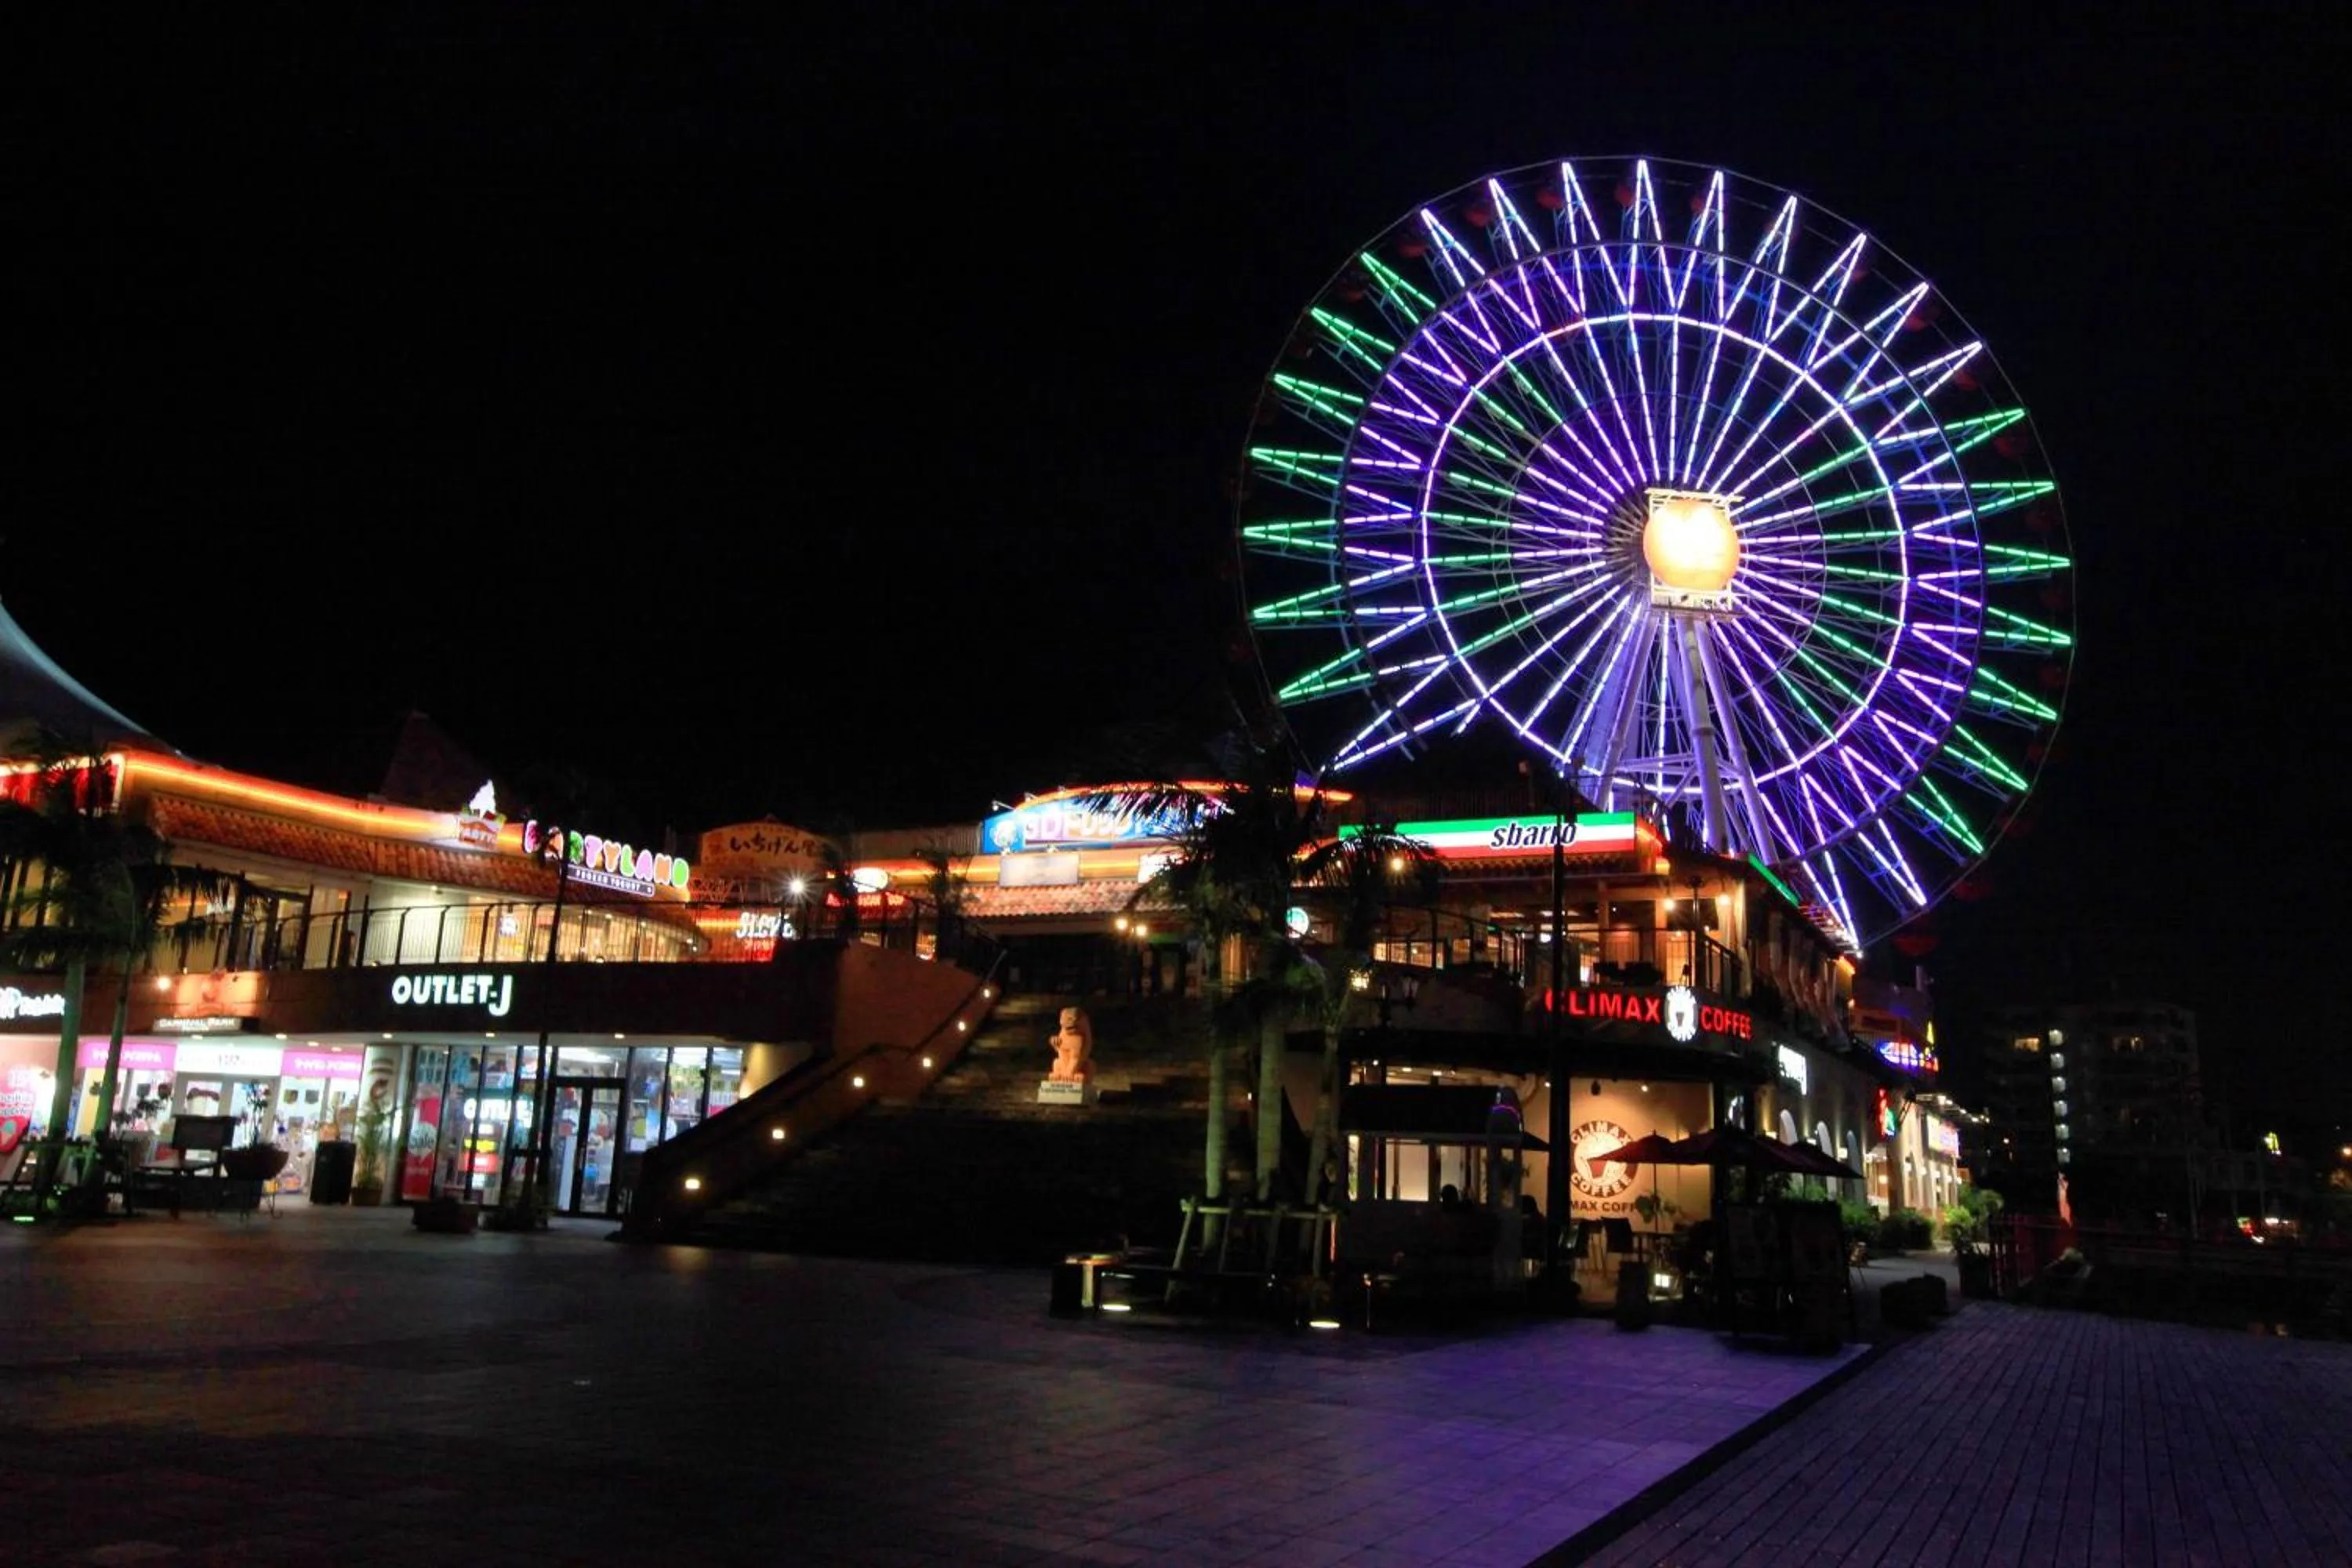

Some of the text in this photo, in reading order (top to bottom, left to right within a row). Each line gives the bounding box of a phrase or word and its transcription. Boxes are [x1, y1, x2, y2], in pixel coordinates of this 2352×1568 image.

[1490, 822, 1577, 847] sbarro
[392, 975, 513, 1017] OUTLET-J
[1700, 1004, 1752, 1040] COFFEE
[1571, 1120, 1632, 1146] CLIMAX
[1571, 1172, 1632, 1197] COFFEE
